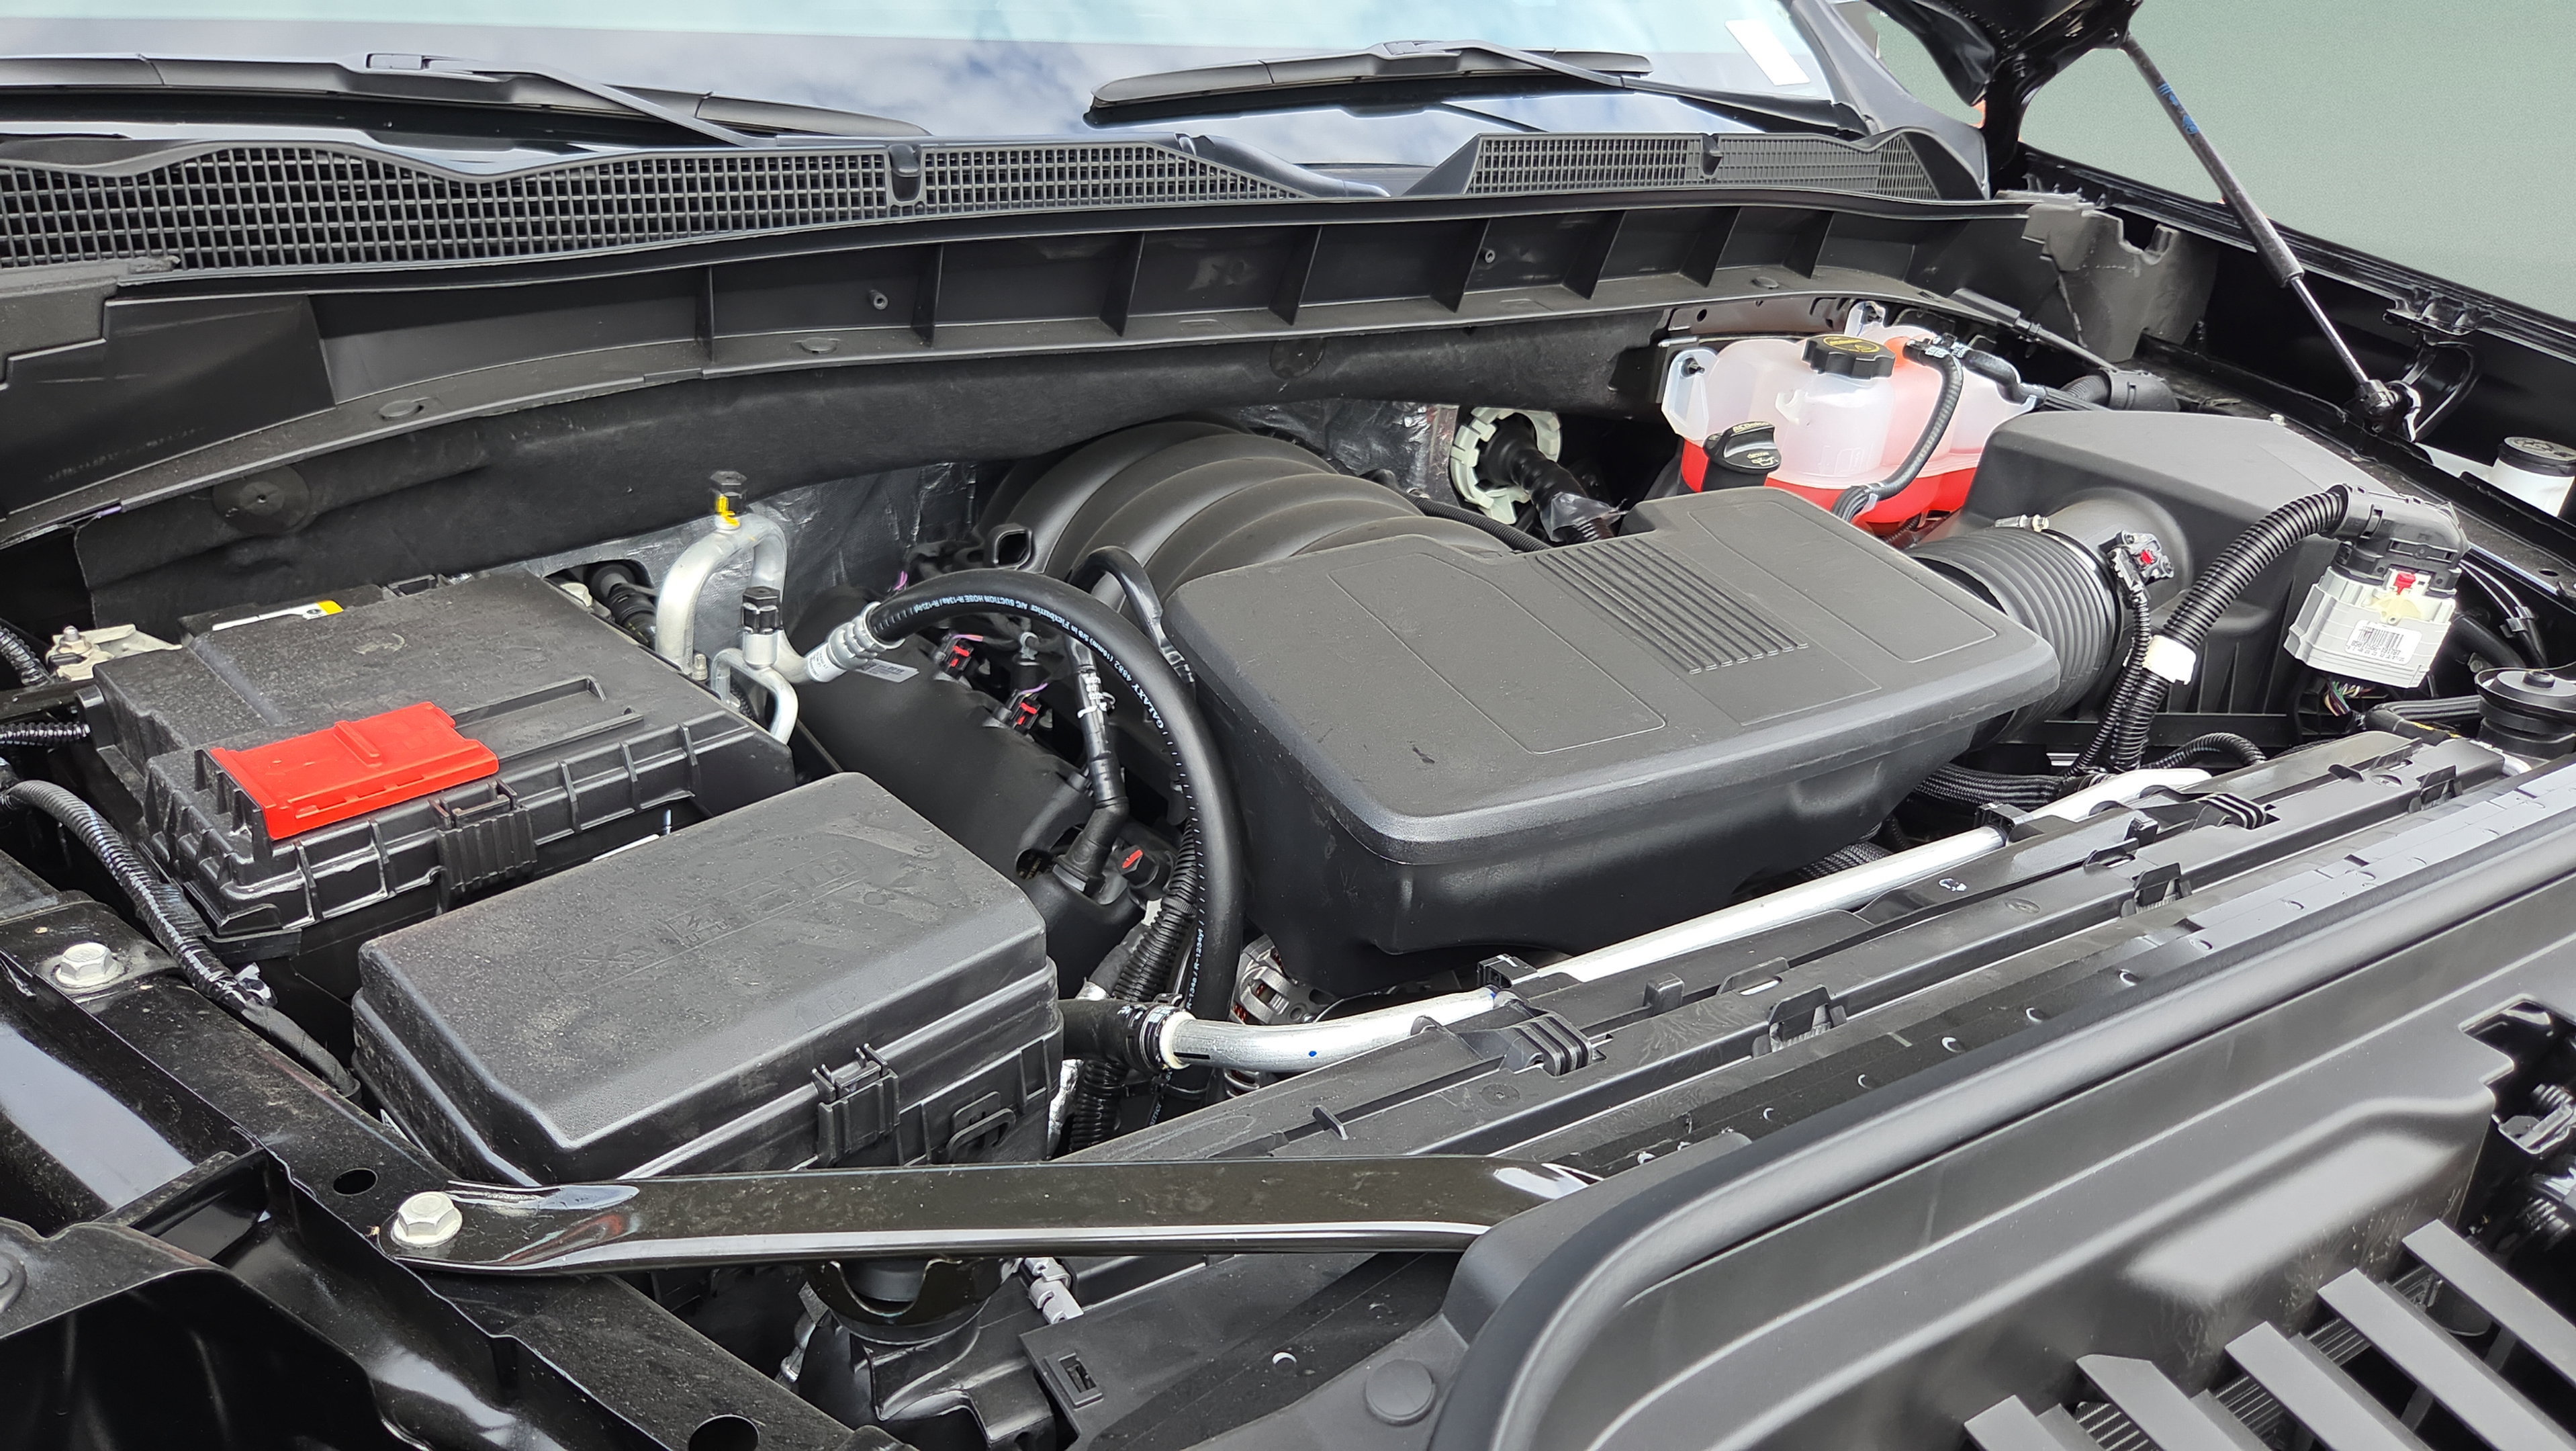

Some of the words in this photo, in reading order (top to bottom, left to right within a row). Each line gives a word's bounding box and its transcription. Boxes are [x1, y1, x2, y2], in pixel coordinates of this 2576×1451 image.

[964, 595, 984, 603] HOSE
[984, 595, 1015, 607] SUCTION
[1015, 600, 1028, 610] A/C
[1114, 660, 1132, 681] 4882
[1132, 684, 1164, 729] GALAXY
[1186, 977, 1197, 1010] R-134a
[1194, 928, 1205, 970] R-1234yf
